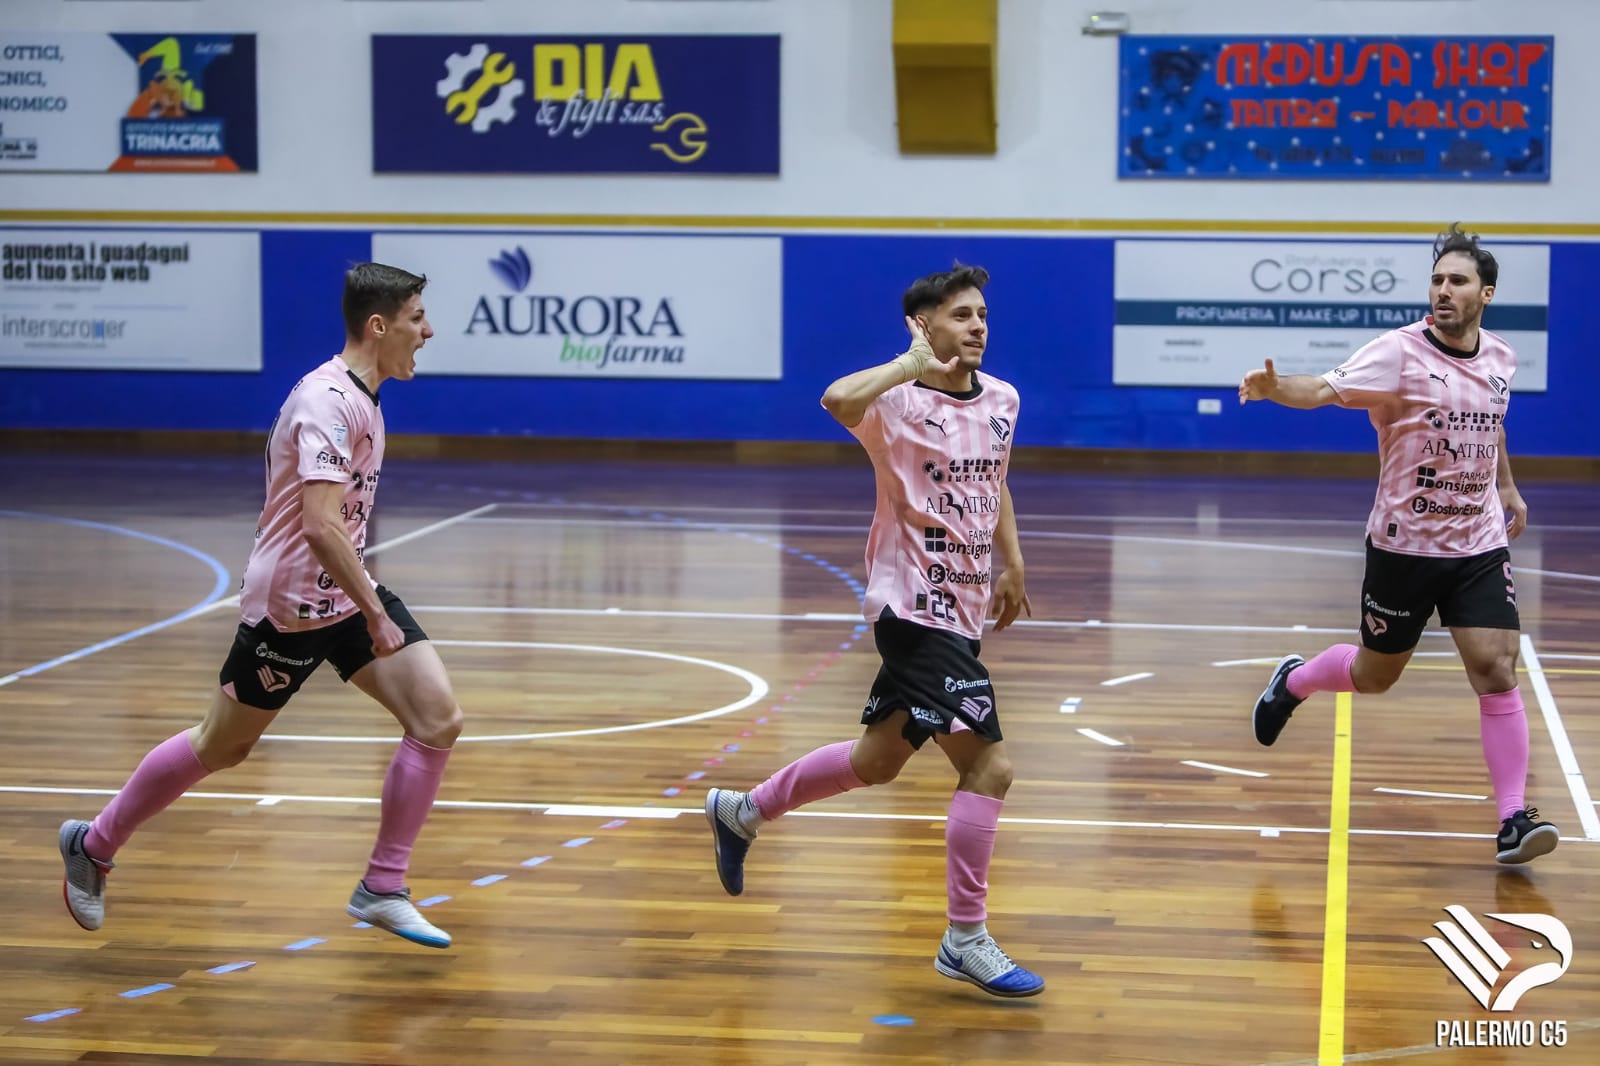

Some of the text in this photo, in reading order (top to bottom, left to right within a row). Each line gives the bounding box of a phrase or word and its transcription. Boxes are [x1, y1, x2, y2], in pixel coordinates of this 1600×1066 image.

[4, 45, 64, 62] OTTICI,
[1216, 41, 1545, 88] MEDUSA SHOP
[533, 43, 663, 101] DIA
[536, 97, 557, 125] &
[548, 88, 622, 137] figli
[1230, 99, 1528, 129] TATTOO PARLOUR
[127, 134, 221, 150] TRINACRIA
[2, 243, 85, 262] aumenta
[100, 243, 189, 265] guadagni
[3, 264, 150, 282] del tuo sito web
[1251, 259, 1405, 294] Corso
[464, 296, 685, 338] AURORA
[1176, 306, 1275, 321] PROFUMERIA
[1289, 308, 1359, 323] MAKE-UP
[560, 337, 685, 369] biofarma
[930, 589, 957, 623] 22
